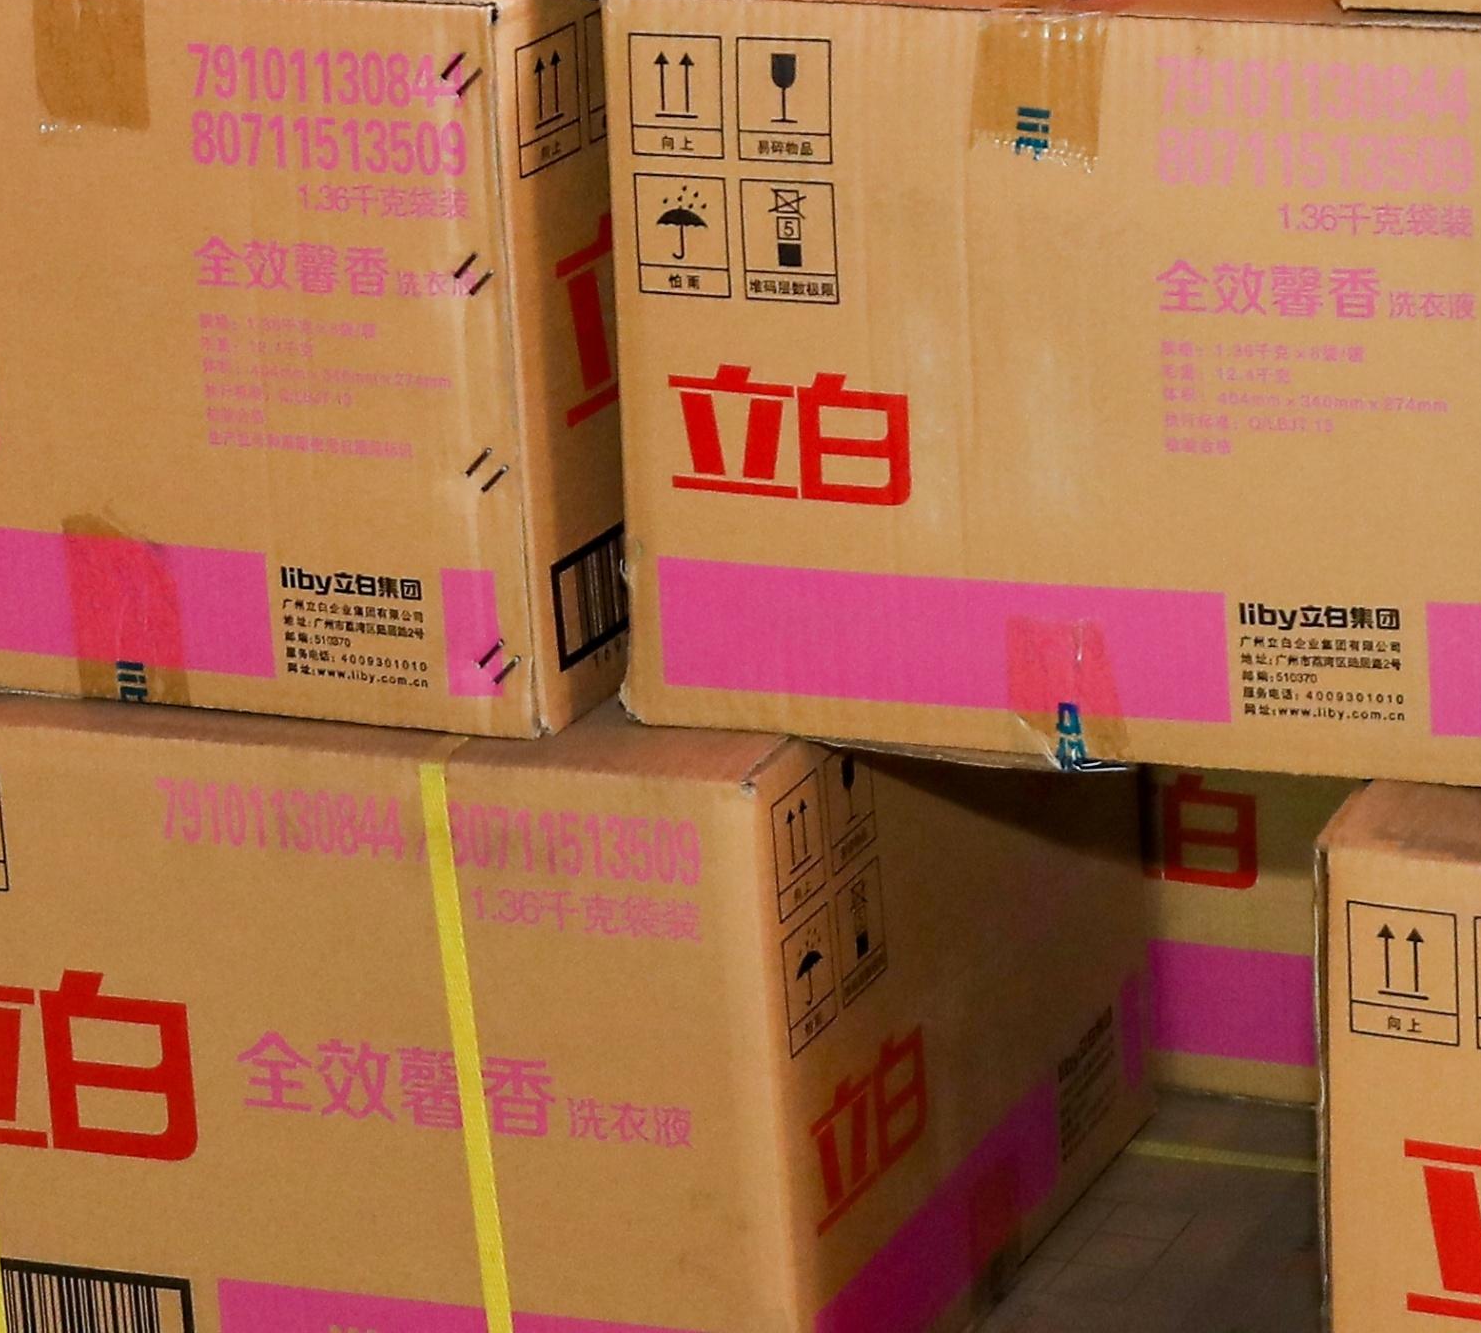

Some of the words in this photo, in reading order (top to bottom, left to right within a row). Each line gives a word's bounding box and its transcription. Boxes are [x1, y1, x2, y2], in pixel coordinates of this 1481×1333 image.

[188, 43, 465, 108] 79101130844
[1158, 56, 1470, 124] 79101130844
[192, 111, 466, 177] 80711513509
[662, 135, 693, 151] 向上
[758, 141, 813, 156] 易碎物品
[1159, 131, 1473, 193] 80711513509
[299, 185, 467, 219] 1.36千克袋装
[1280, 203, 1471, 237] 1.36千克袋装
[195, 237, 389, 297] 全效馨香
[1157, 260, 1379, 319] 全效馨香
[1391, 292, 1473, 319] 洗衣液
[670, 366, 911, 505] 立白
[281, 567, 421, 603] liby立白集团
[1239, 603, 1400, 630] liby立白集团
[1239, 635, 1401, 654] 广州立白企业集团有限公司
[1244, 702, 1405, 722] 网址:www.liby.com.cn
[1306, 691, 1405, 706] 4009301010
[157, 778, 407, 859] 79101130844
[450, 802, 701, 886] 80711513509
[1147, 774, 1258, 889] 白
[471, 883, 700, 943] 1.36千克袋装
[1385, 1015, 1424, 1034] 向上
[237, 1032, 556, 1137] 全效馨香
[568, 1099, 691, 1147] 洗衣液
[810, 1026, 928, 1235] 立白
